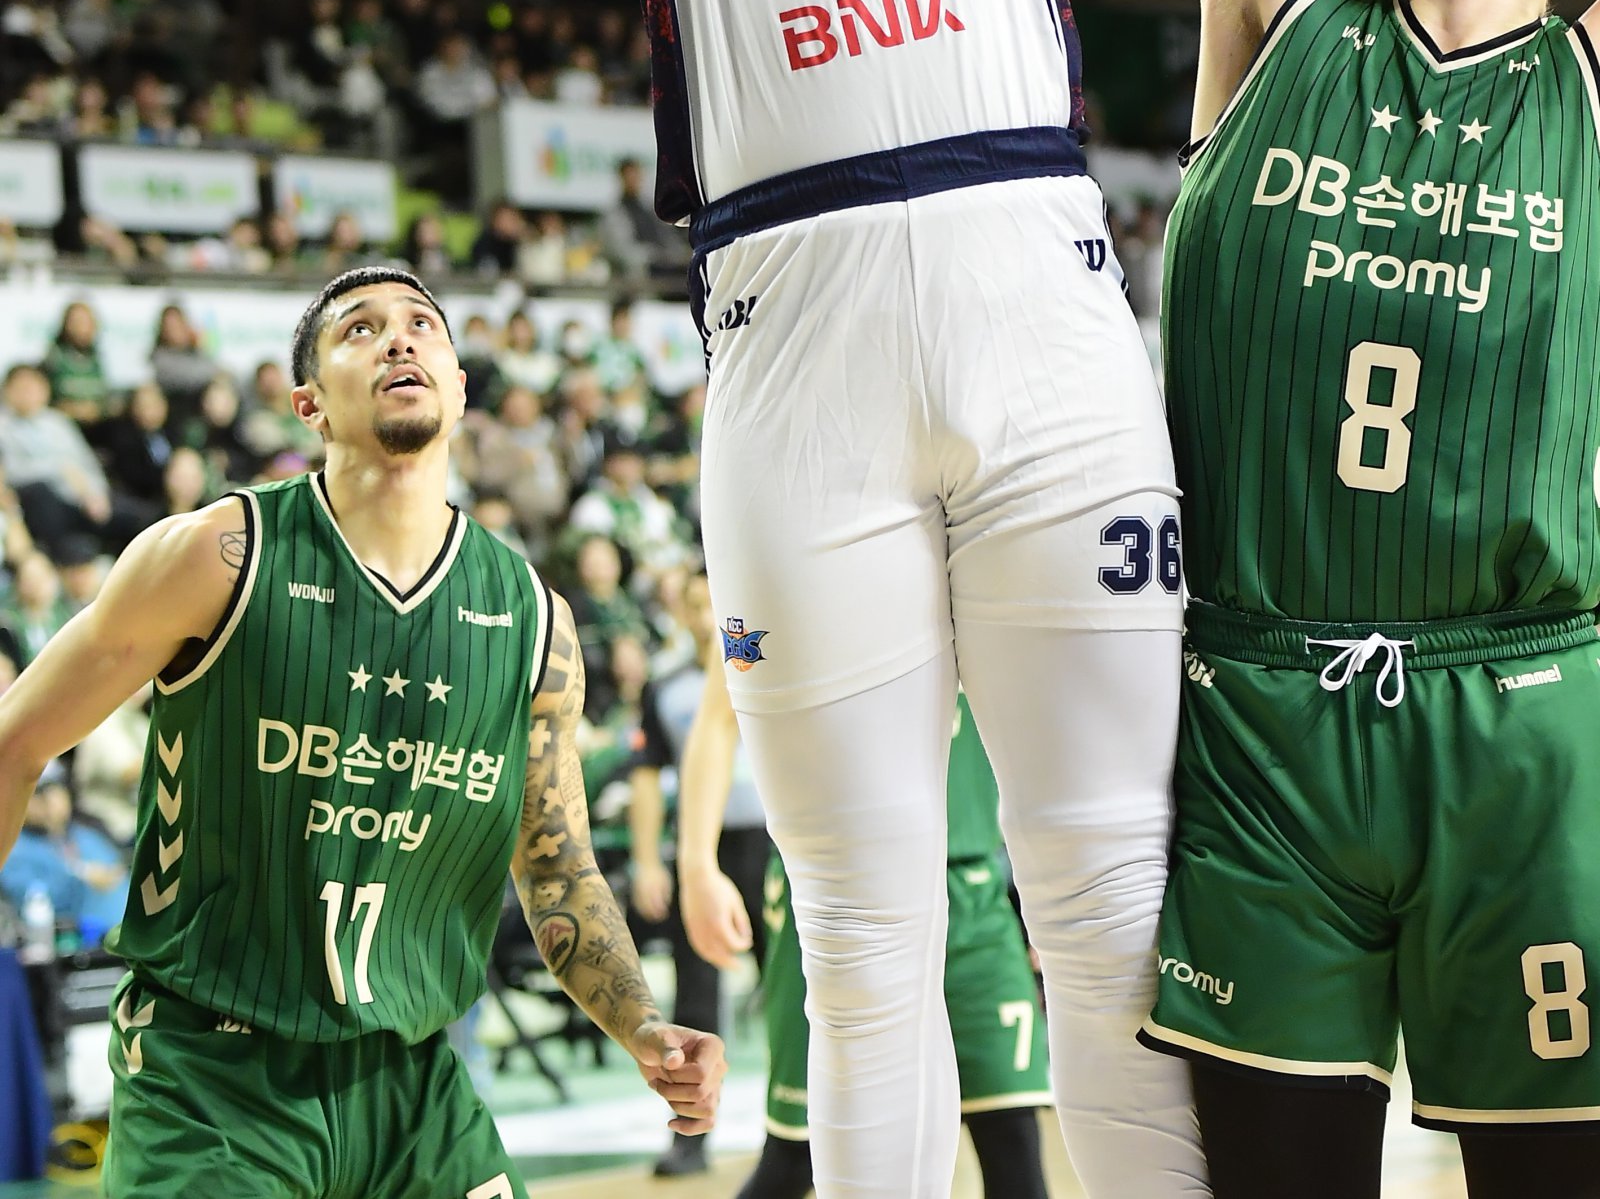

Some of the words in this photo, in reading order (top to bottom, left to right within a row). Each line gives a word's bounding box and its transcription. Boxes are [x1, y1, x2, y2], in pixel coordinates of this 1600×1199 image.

[1252, 148, 1564, 253] DB손해보험
[1303, 240, 1491, 313] promy
[1336, 340, 1422, 494] 8
[1097, 515, 1182, 596] 36
[288, 582, 336, 604] WONJU
[458, 606, 513, 628] hummel
[1495, 663, 1563, 694] hummel
[318, 880, 387, 1006] 17
[1158, 953, 1235, 1006] romy
[998, 1000, 1034, 1072] 7
[1519, 941, 1592, 1061] 8
